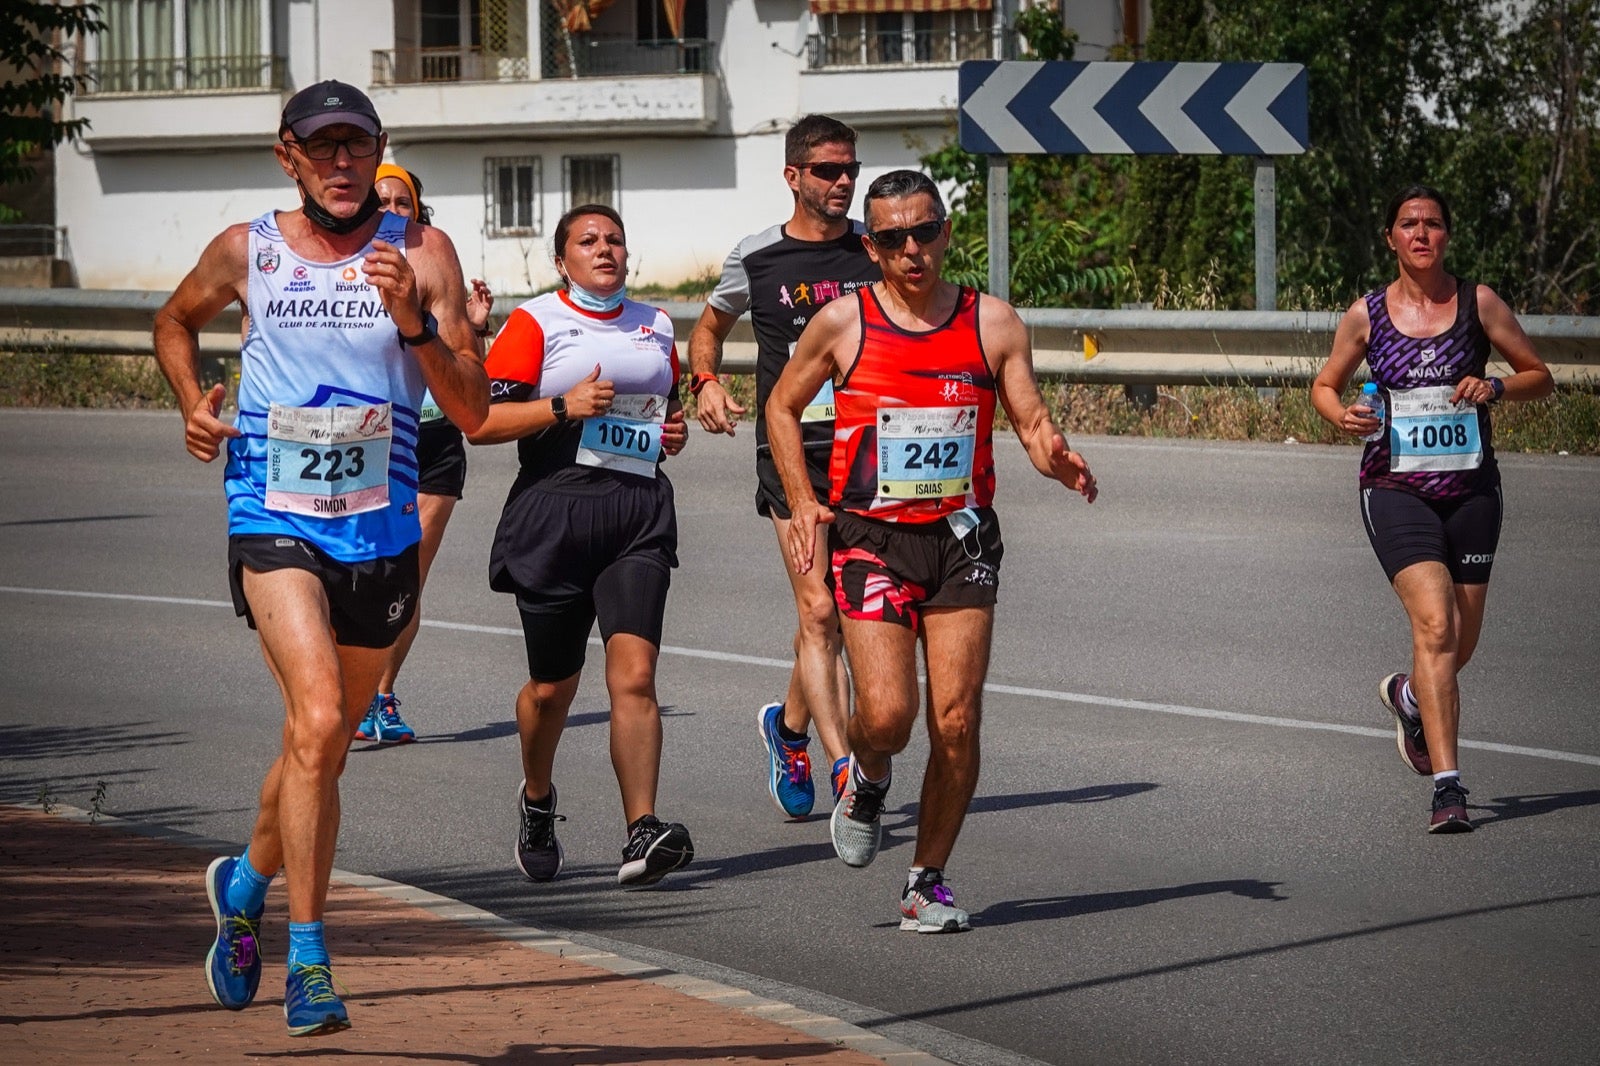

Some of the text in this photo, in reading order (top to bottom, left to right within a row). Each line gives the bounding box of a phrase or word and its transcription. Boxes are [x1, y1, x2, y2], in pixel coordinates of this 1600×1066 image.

[265, 299, 390, 319] MARACENA
[279, 321, 303, 329] CLUB
[320, 321, 375, 329] ATLETISMO
[1407, 364, 1453, 378] WAVE
[490, 381, 518, 396] CK
[421, 408, 434, 418] RIO
[598, 422, 650, 453] 1070
[1407, 424, 1467, 448] 1008
[904, 441, 959, 469] 242
[272, 454, 281, 482] MASTER
[300, 446, 365, 482] 223
[915, 483, 943, 495] ISAIAS
[314, 498, 347, 513] SIMON
